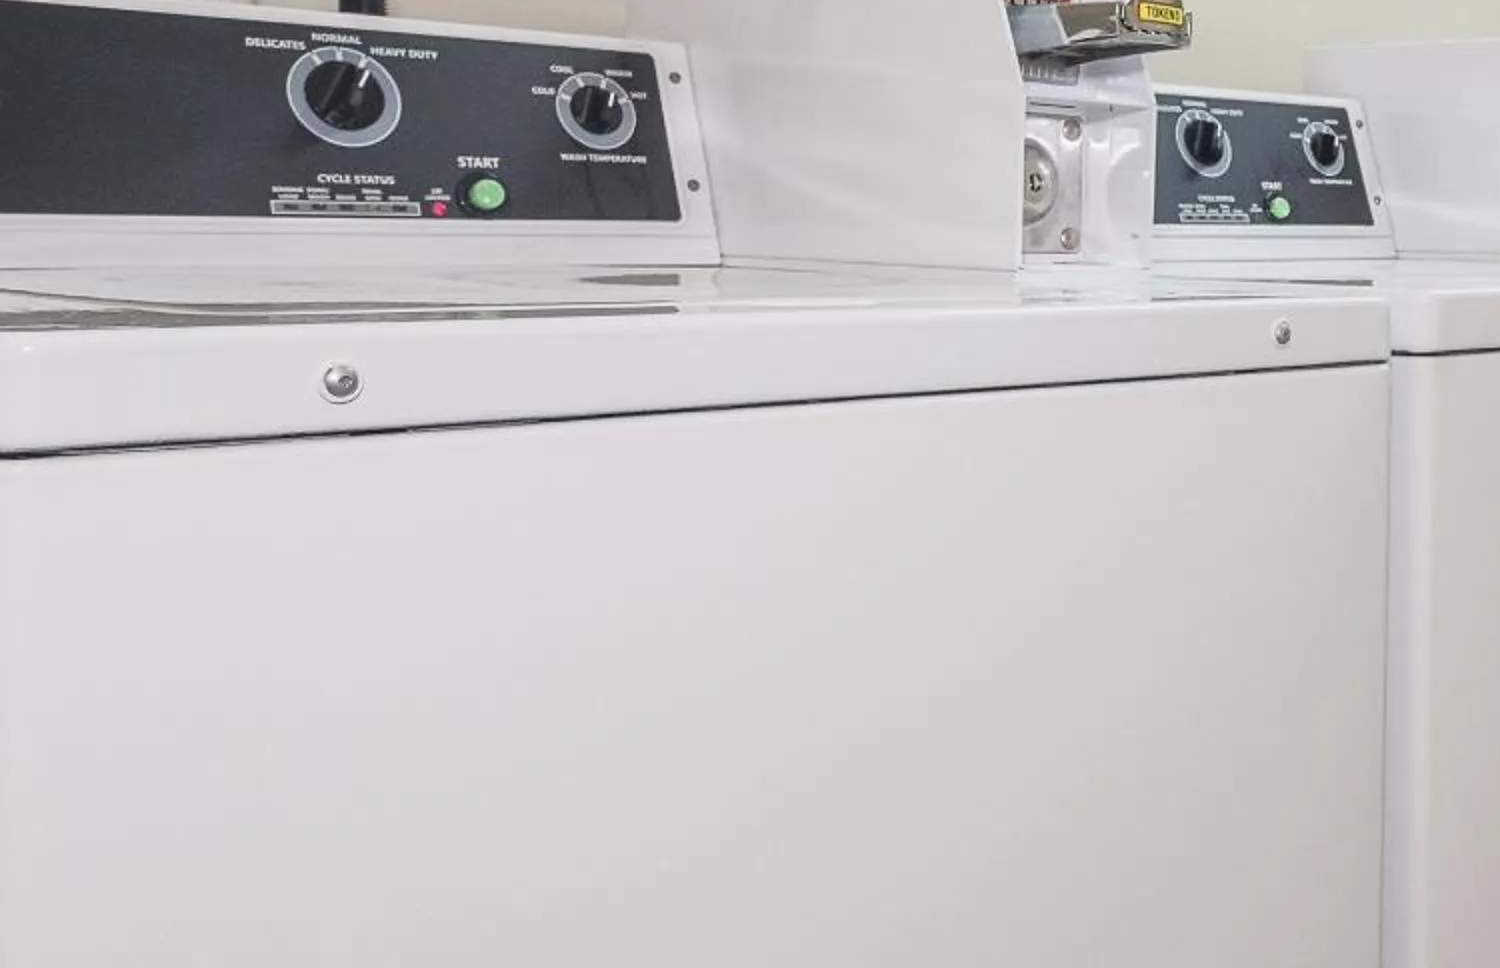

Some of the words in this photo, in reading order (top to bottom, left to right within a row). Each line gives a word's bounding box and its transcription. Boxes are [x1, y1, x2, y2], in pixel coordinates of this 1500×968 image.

[245, 36, 307, 51] DELICATES
[311, 33, 363, 45] NORMAL
[370, 46, 406, 59] HEAVY
[409, 49, 439, 61] DUTY
[457, 156, 500, 169] START
[317, 173, 351, 183] CYCLE
[354, 175, 396, 185] STATUS
